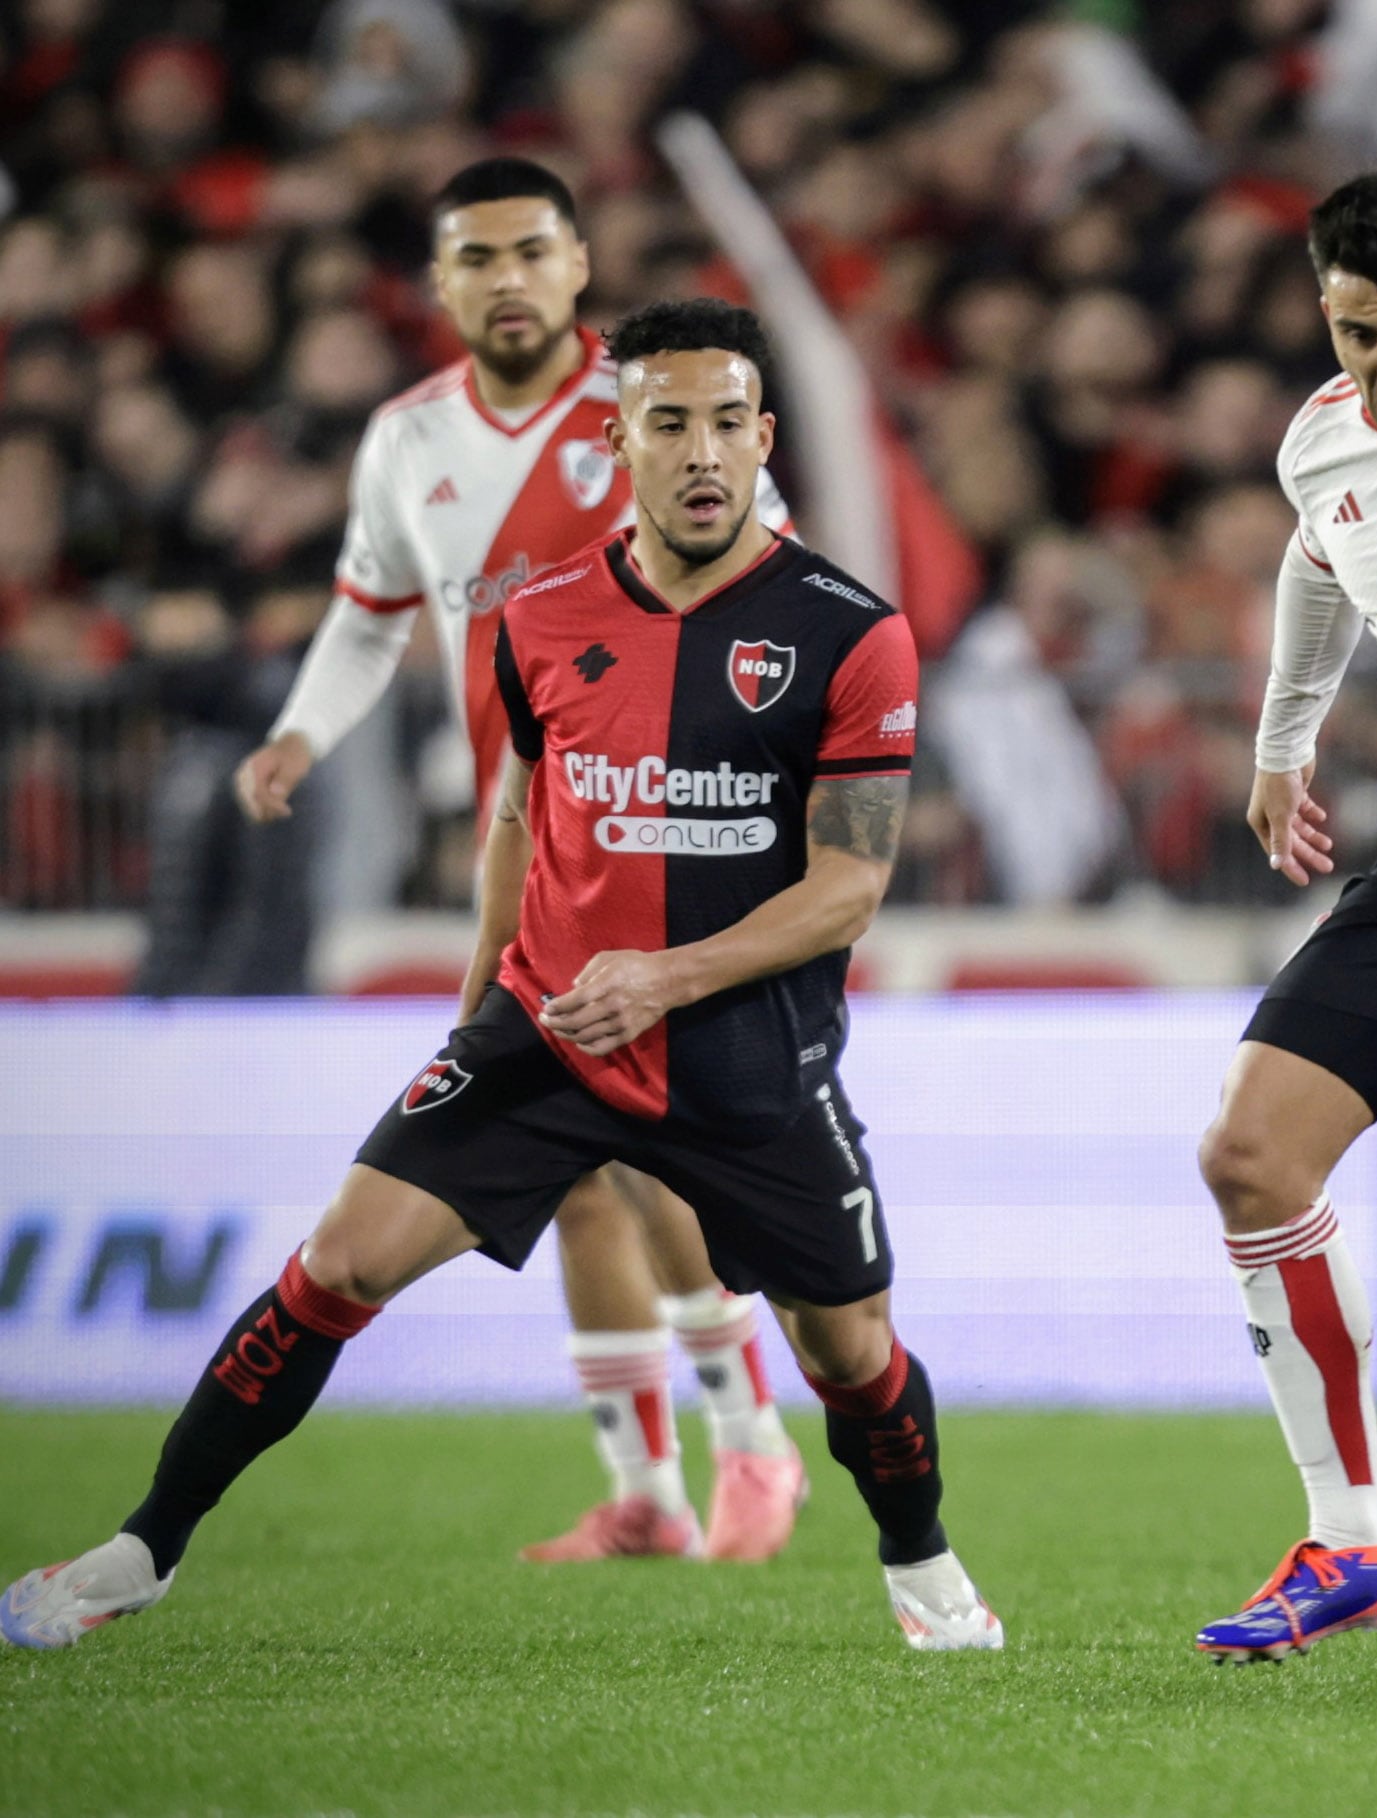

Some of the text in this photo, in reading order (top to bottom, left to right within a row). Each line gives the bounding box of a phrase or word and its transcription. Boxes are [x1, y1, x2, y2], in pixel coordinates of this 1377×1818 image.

[802, 573, 869, 608] ACRIL
[739, 658, 782, 679] NOB
[418, 1072, 453, 1093] NOB
[842, 1186, 878, 1265] 7
